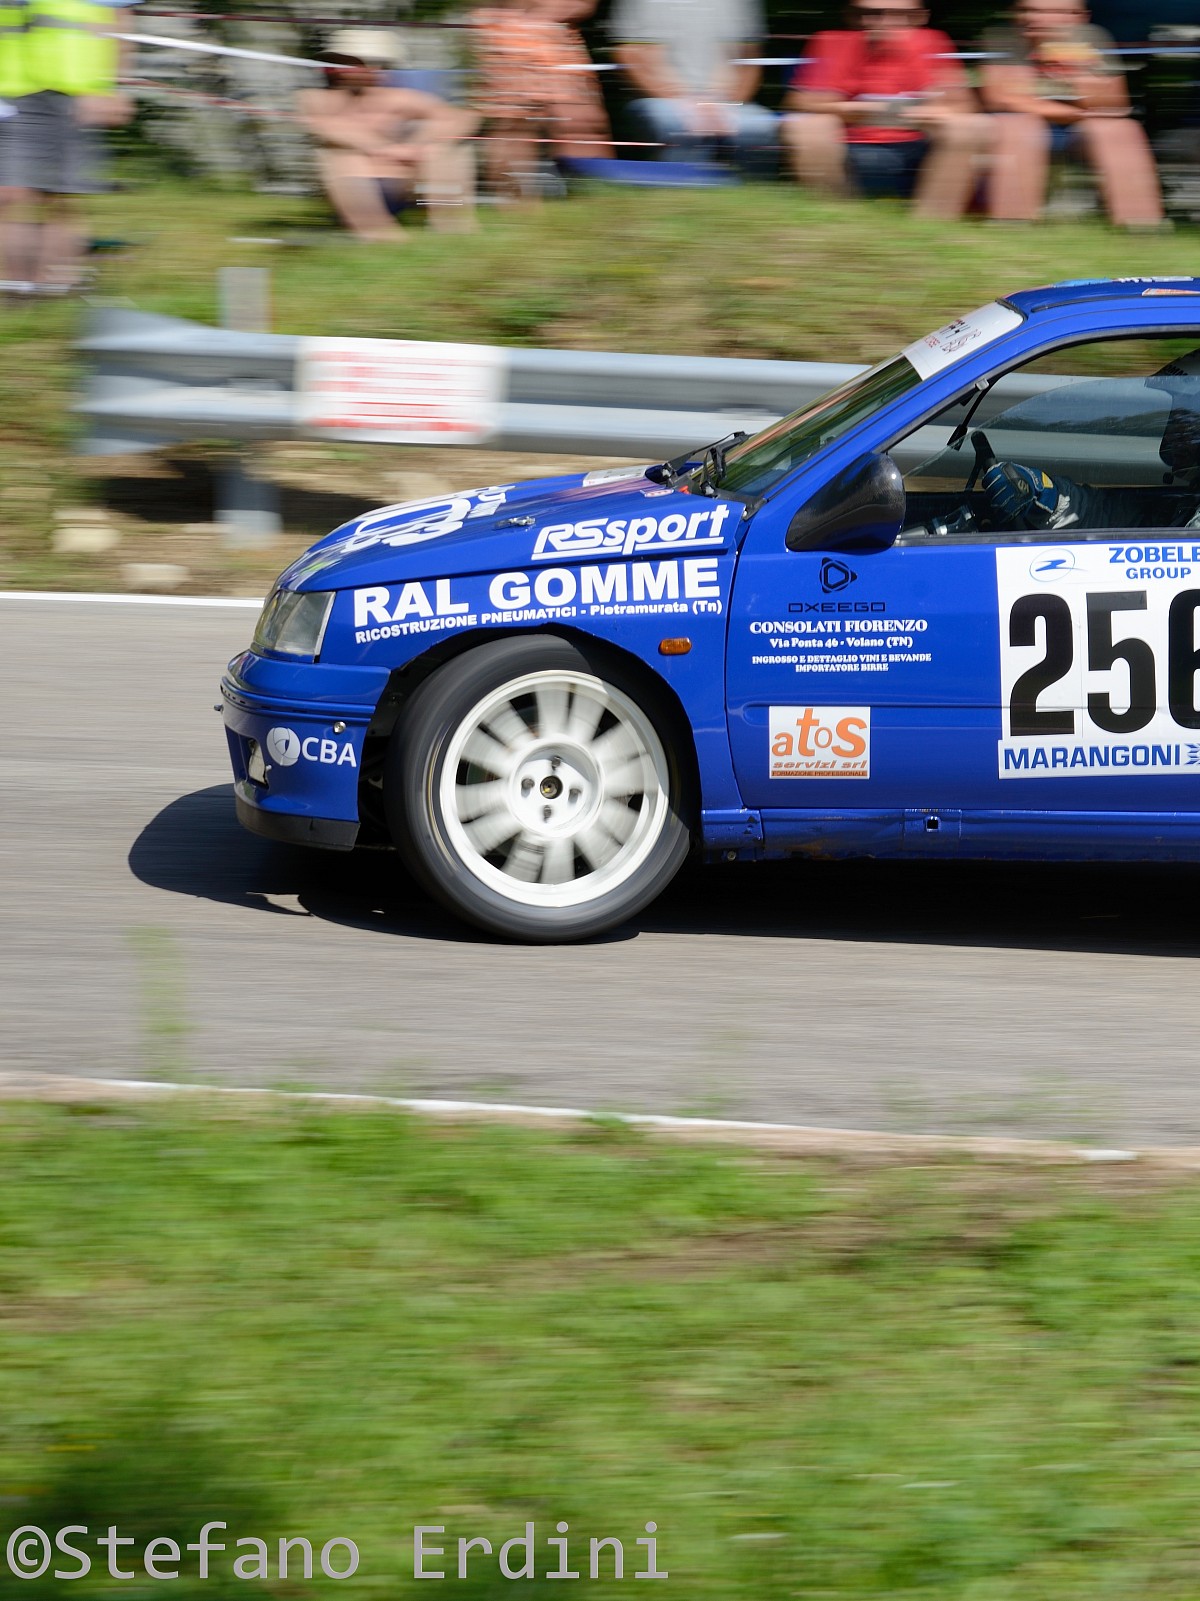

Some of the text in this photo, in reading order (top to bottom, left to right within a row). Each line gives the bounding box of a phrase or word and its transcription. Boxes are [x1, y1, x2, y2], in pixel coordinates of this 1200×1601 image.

[531, 504, 730, 561] RSsport
[1125, 567, 1192, 580] GROUP
[354, 558, 721, 628] RAL GOMME
[355, 614, 478, 644] RICOSTRUZIONE
[481, 606, 577, 625] PNEUMATICI
[590, 601, 689, 616] Pietramurata
[692, 599, 723, 616] (Tn)
[750, 619, 928, 634] CONSOLATI FIORENZO
[769, 638, 790, 648] Via
[825, 638, 839, 649] 46
[846, 637, 884, 648] Volano
[886, 636, 913, 648] (TN)
[752, 656, 798, 665] INGROSSO
[807, 655, 858, 664] DETTAGLIO
[859, 654, 880, 663] VINI
[881, 654, 888, 662] E
[888, 653, 932, 662] BEVANDE
[795, 663, 889, 673] IMPORTATORE BIRRE
[302, 736, 357, 768] CBA
[1004, 744, 1181, 770] MARANGONI
[773, 759, 868, 769] servizi srl
